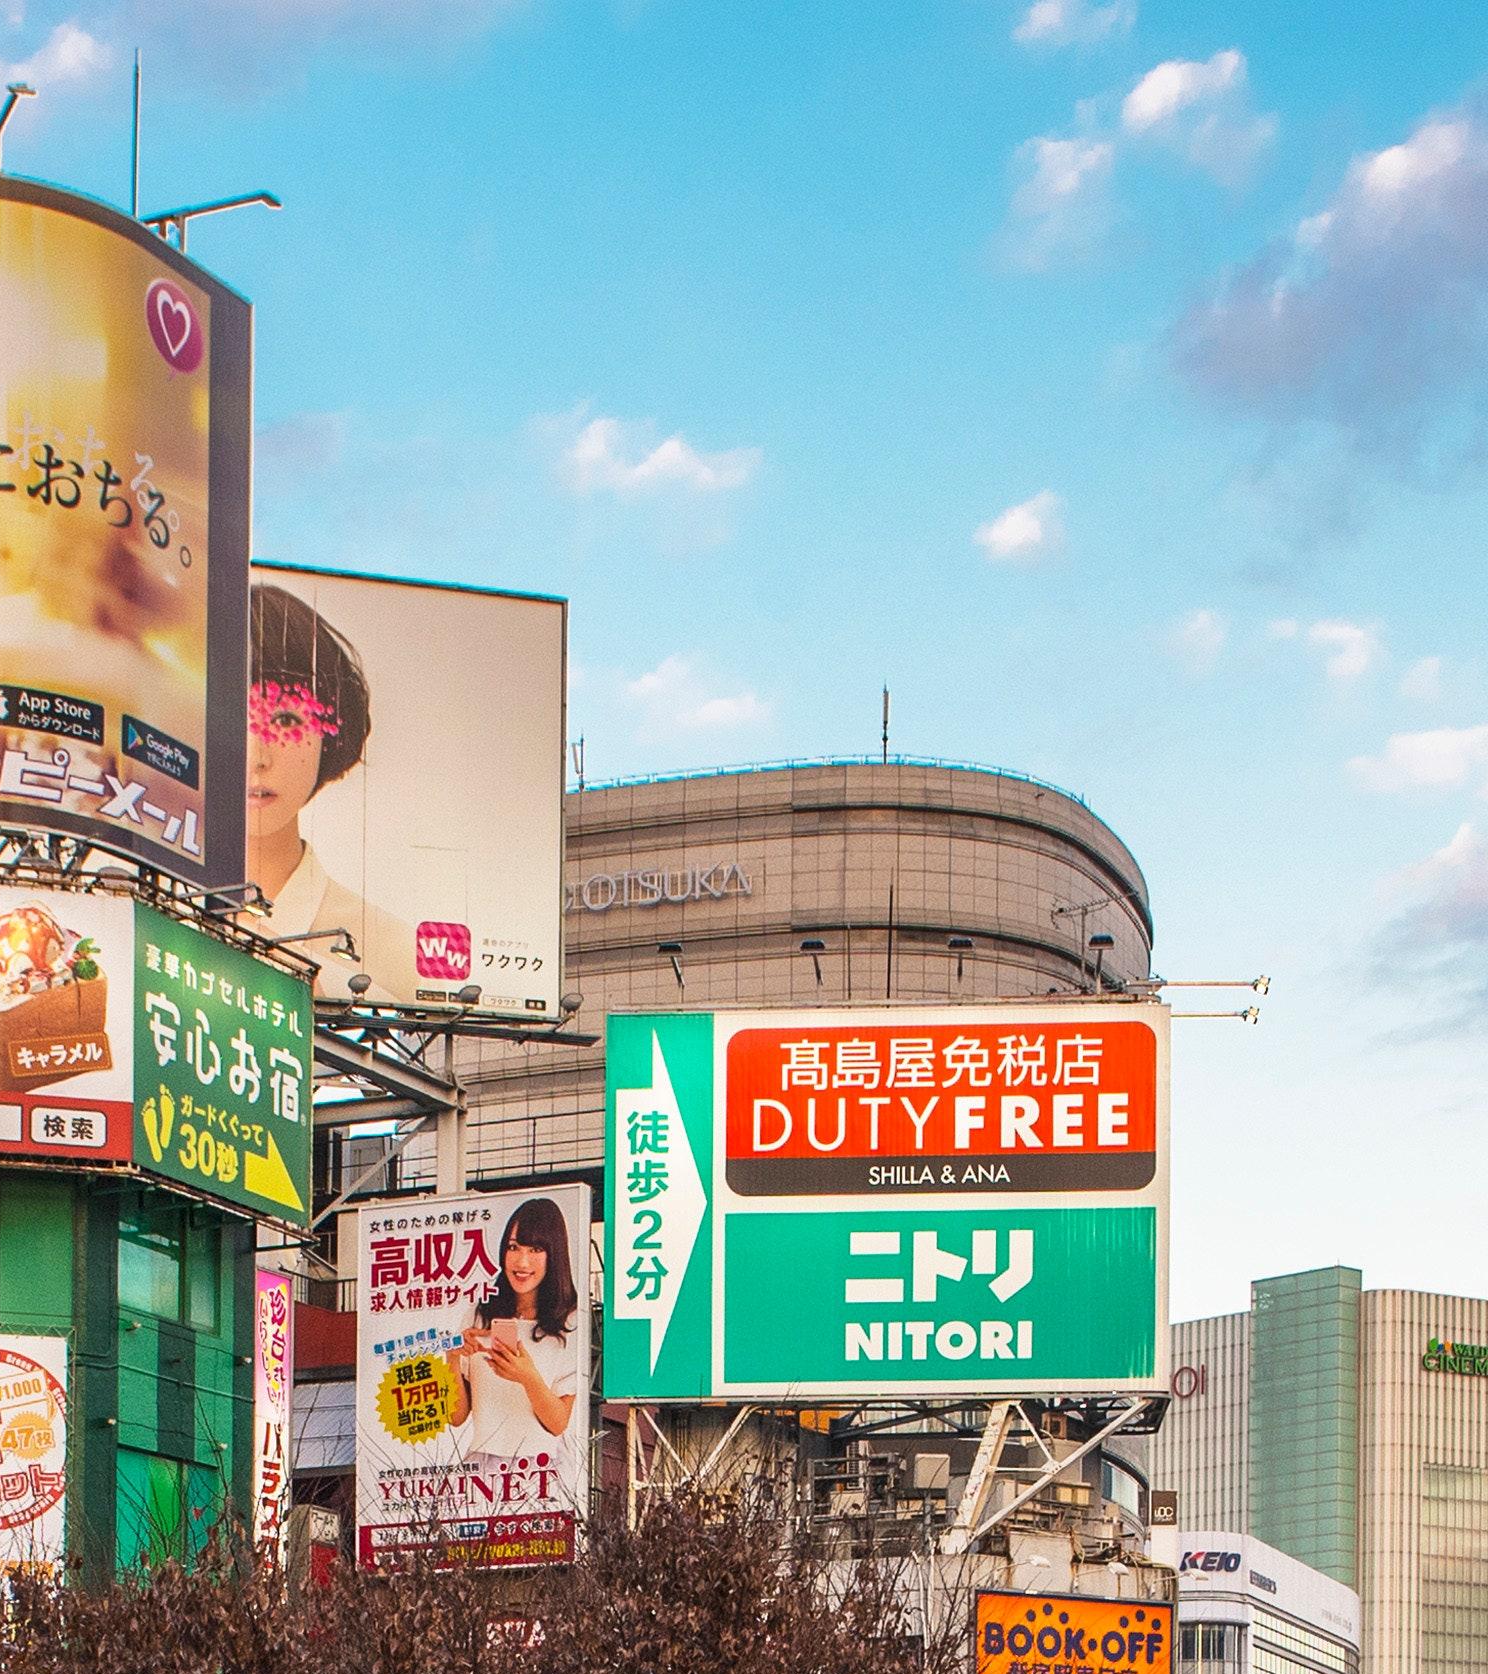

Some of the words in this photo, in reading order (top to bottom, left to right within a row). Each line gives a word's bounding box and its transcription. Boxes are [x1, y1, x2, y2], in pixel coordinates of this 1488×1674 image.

[19, 691, 51, 714] App
[54, 697, 91, 720] Store
[17, 711, 101, 739] からダウンロード
[482, 954, 543, 971] ワクワク
[145, 943, 302, 1037] 豪華カプセルホテル
[17, 1043, 103, 1069] キャラメル
[144, 991, 303, 1123] 安心お宿
[43, 1115, 94, 1140] 検索
[181, 1094, 263, 1146] ガードくぐって
[178, 1122, 238, 1182] 30秒
[868, 1165, 935, 1185] SHILLA
[941, 1166, 956, 1184] &
[962, 1165, 1010, 1184] ANA
[627, 1111, 669, 1300] 徒歩2分
[369, 1210, 492, 1233] 女性のための稼げる
[370, 1229, 498, 1289] 高収入
[845, 1230, 1033, 1303] ニトリ
[370, 1283, 498, 1312] 求人情報サイト
[845, 1321, 1031, 1361] NITORI
[396, 1361, 432, 1385] 現金
[1180, 1551, 1241, 1574] KEIO
